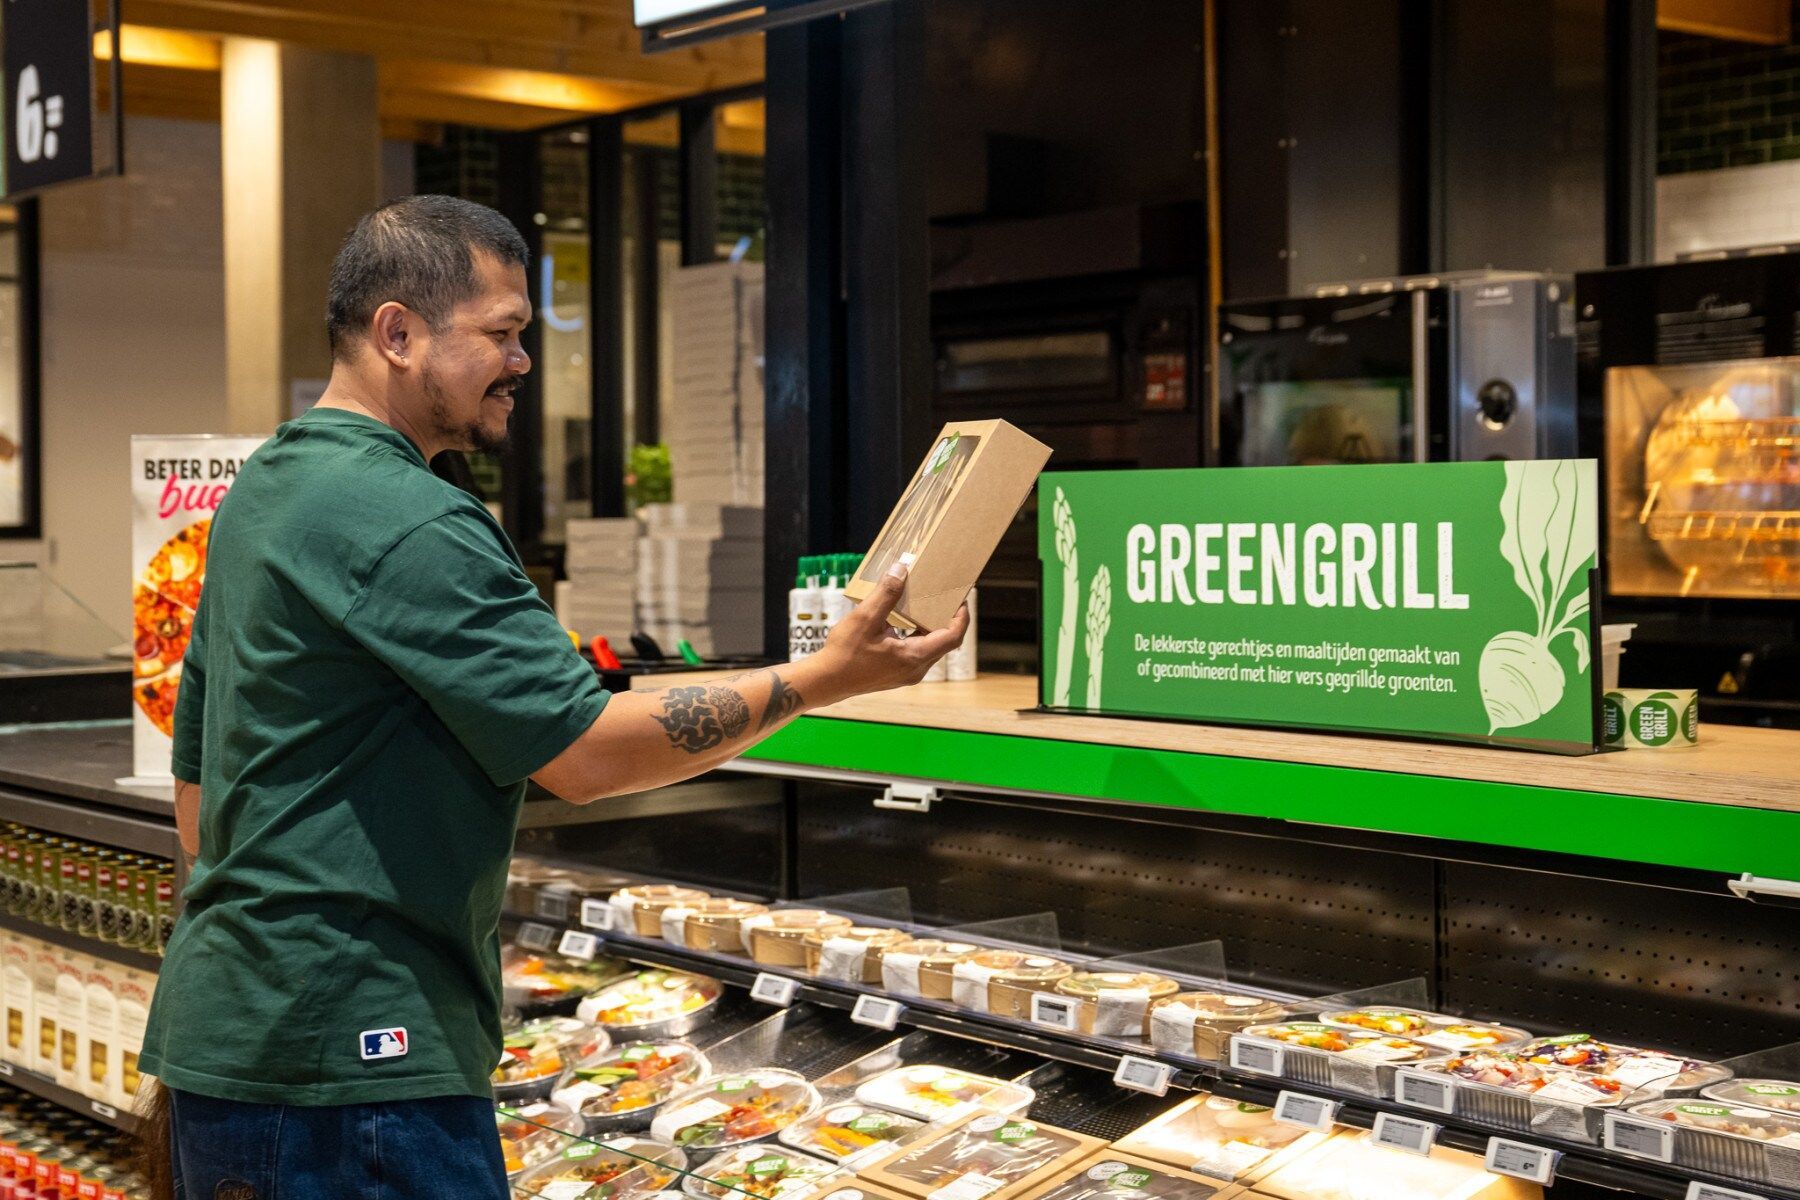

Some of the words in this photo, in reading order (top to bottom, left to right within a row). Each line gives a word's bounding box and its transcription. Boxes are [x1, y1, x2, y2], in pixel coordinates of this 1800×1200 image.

[144, 459, 202, 480] BETER
[209, 459, 246, 480] DA
[1134, 633, 1150, 652] De
[1151, 634, 1206, 654] lekkerste
[1208, 638, 1274, 662] gerechtjes
[1275, 644, 1292, 658] en
[1294, 641, 1367, 666] maaltijden
[1368, 645, 1432, 668] gemaakt
[1434, 650, 1460, 666] van
[1137, 658, 1151, 676] of
[1152, 661, 1238, 682] gecombineerd
[1240, 666, 1265, 683] met
[1268, 665, 1293, 684] hier
[1295, 670, 1323, 686] vers
[1325, 669, 1386, 693] gegrillde
[1388, 674, 1457, 696] groenten.
[1639, 706, 1654, 740] GREEN
[1653, 708, 1668, 738] GRILL
